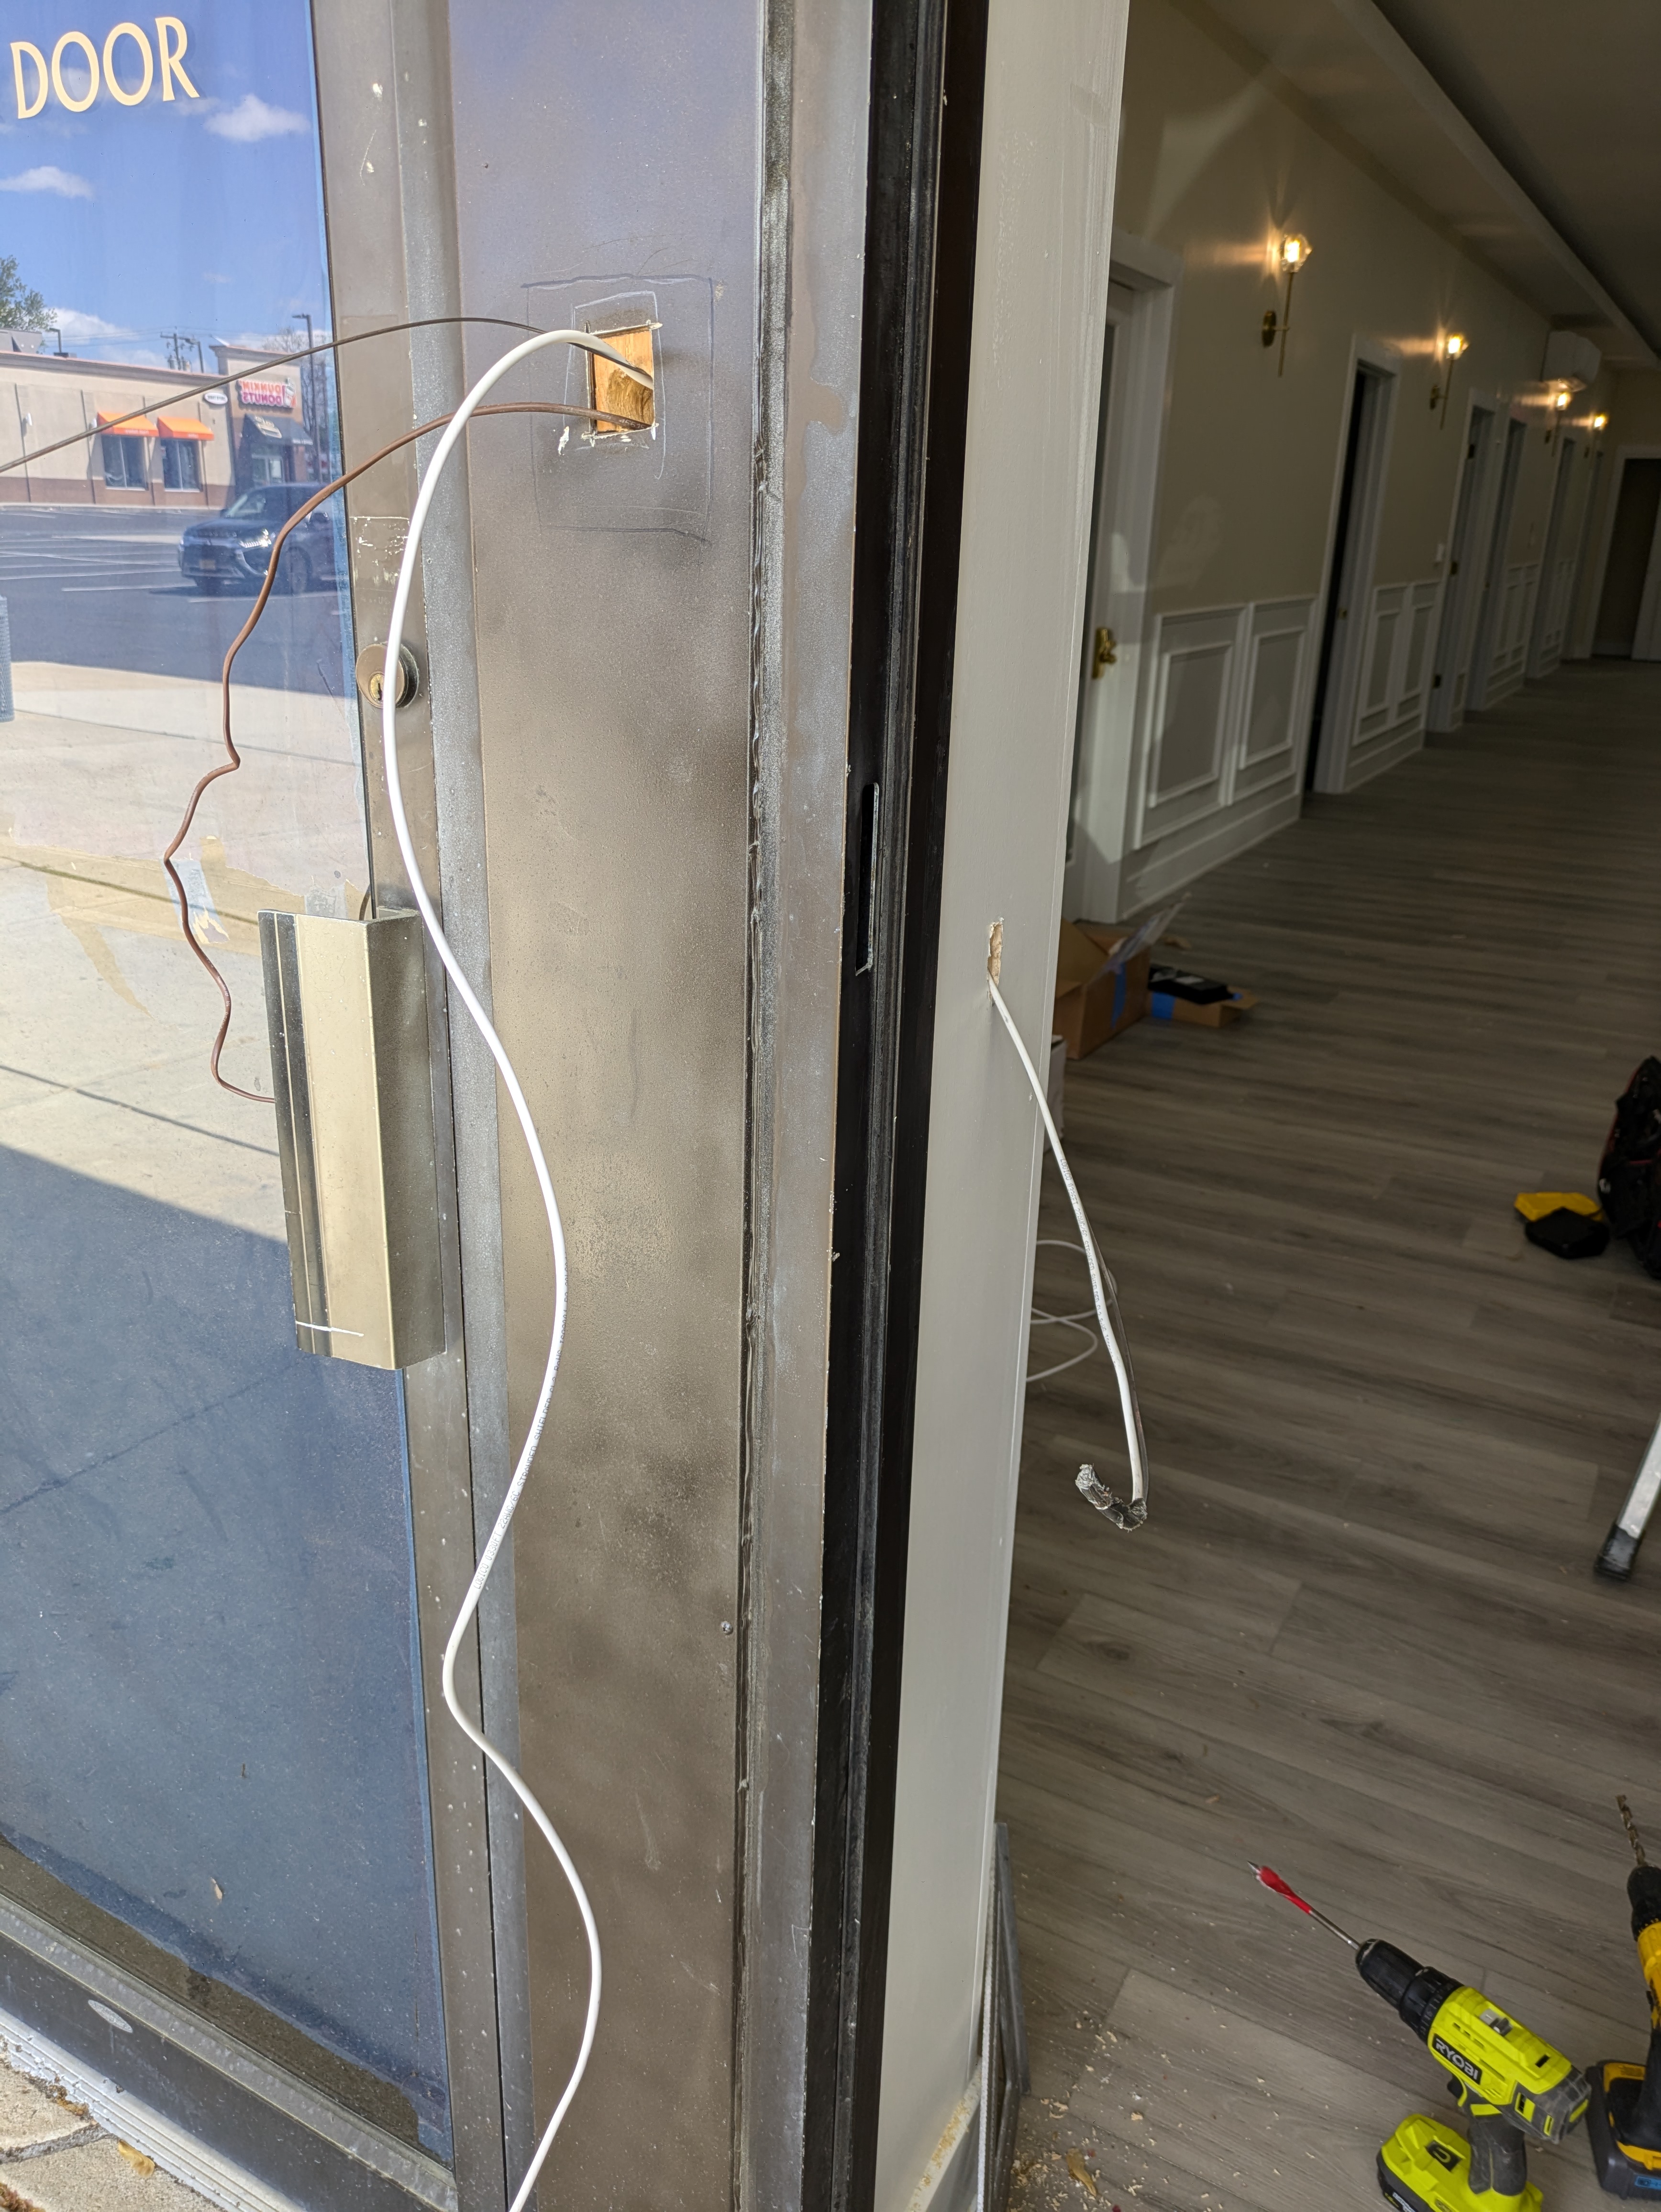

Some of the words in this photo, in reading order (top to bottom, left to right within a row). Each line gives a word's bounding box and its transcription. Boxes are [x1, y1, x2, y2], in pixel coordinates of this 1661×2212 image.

[10, 17, 199, 119] DOOR
[473, 1563, 489, 1589] LOGICO
[1436, 2038, 1479, 2080] RYOBI
